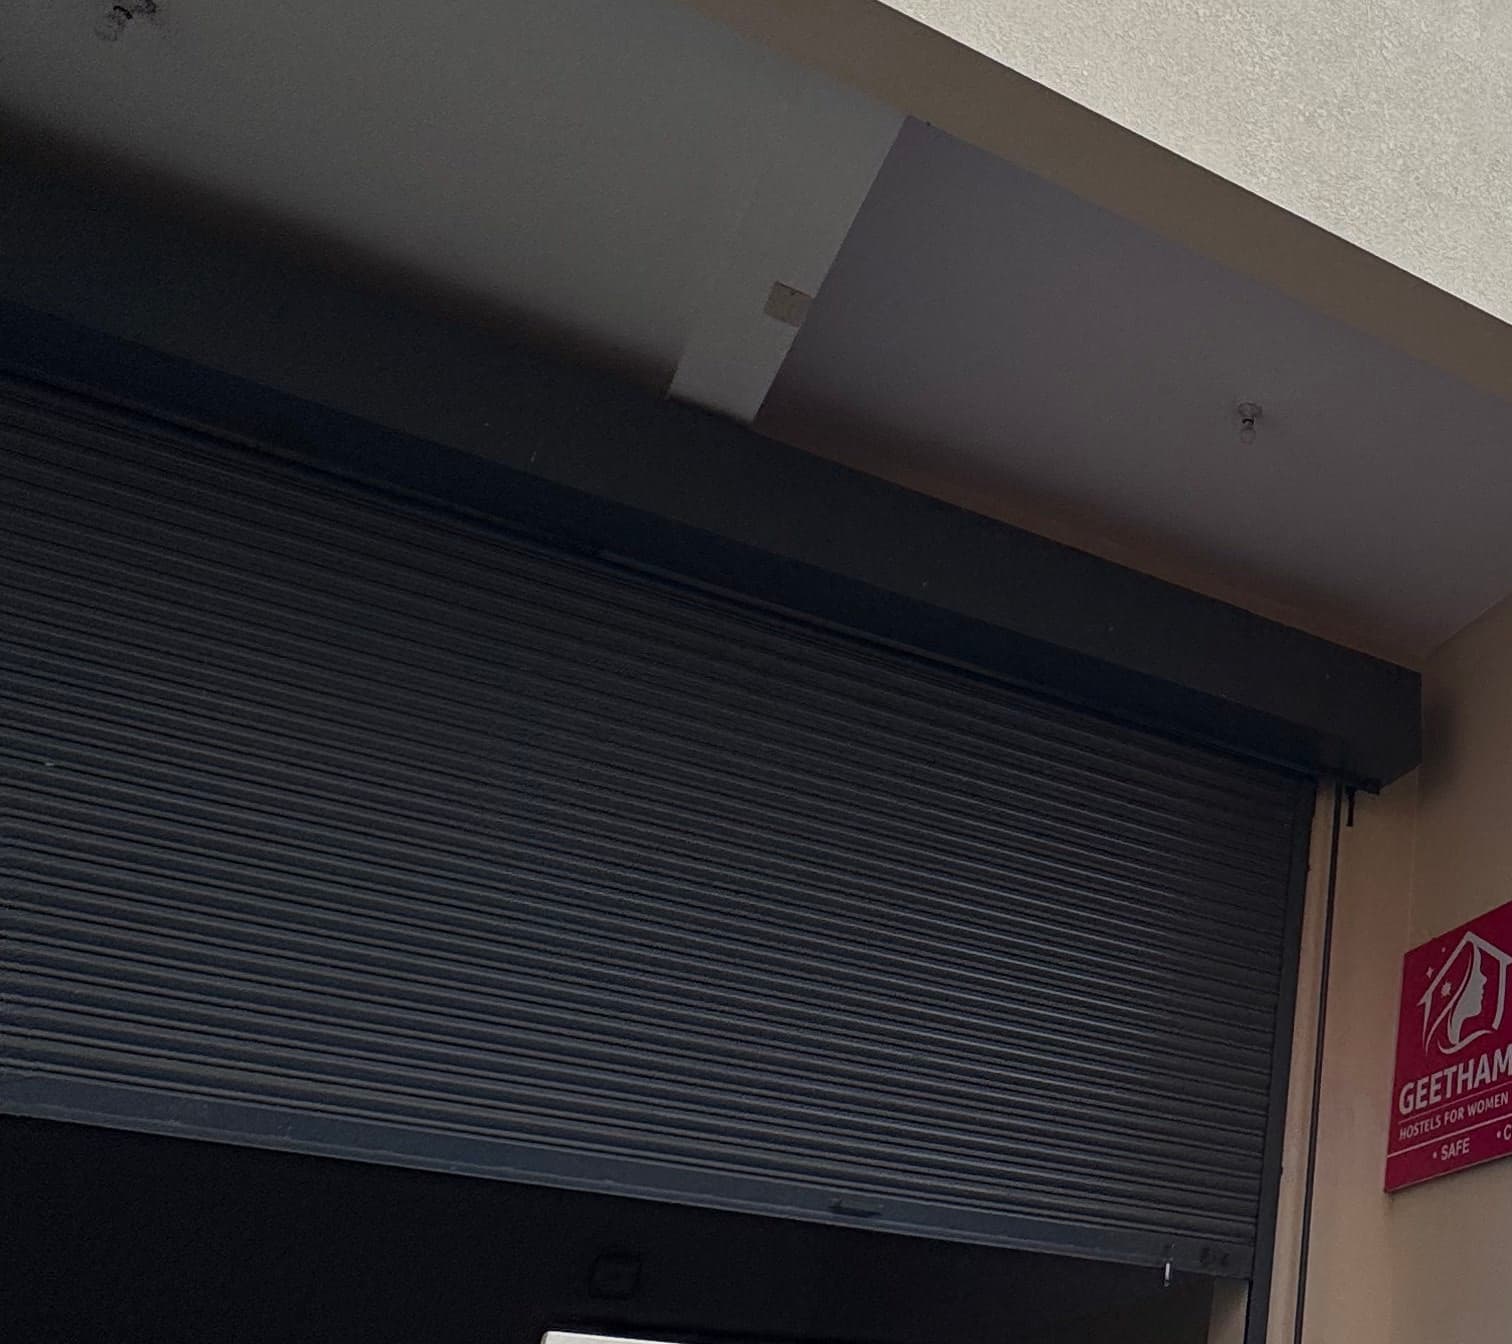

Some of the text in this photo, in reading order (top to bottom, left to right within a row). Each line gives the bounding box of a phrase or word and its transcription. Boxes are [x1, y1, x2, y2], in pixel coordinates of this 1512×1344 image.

[1399, 1091, 1510, 1141] HOSTELS FOR WOMEN
[1440, 1137, 1471, 1162] SAFE
